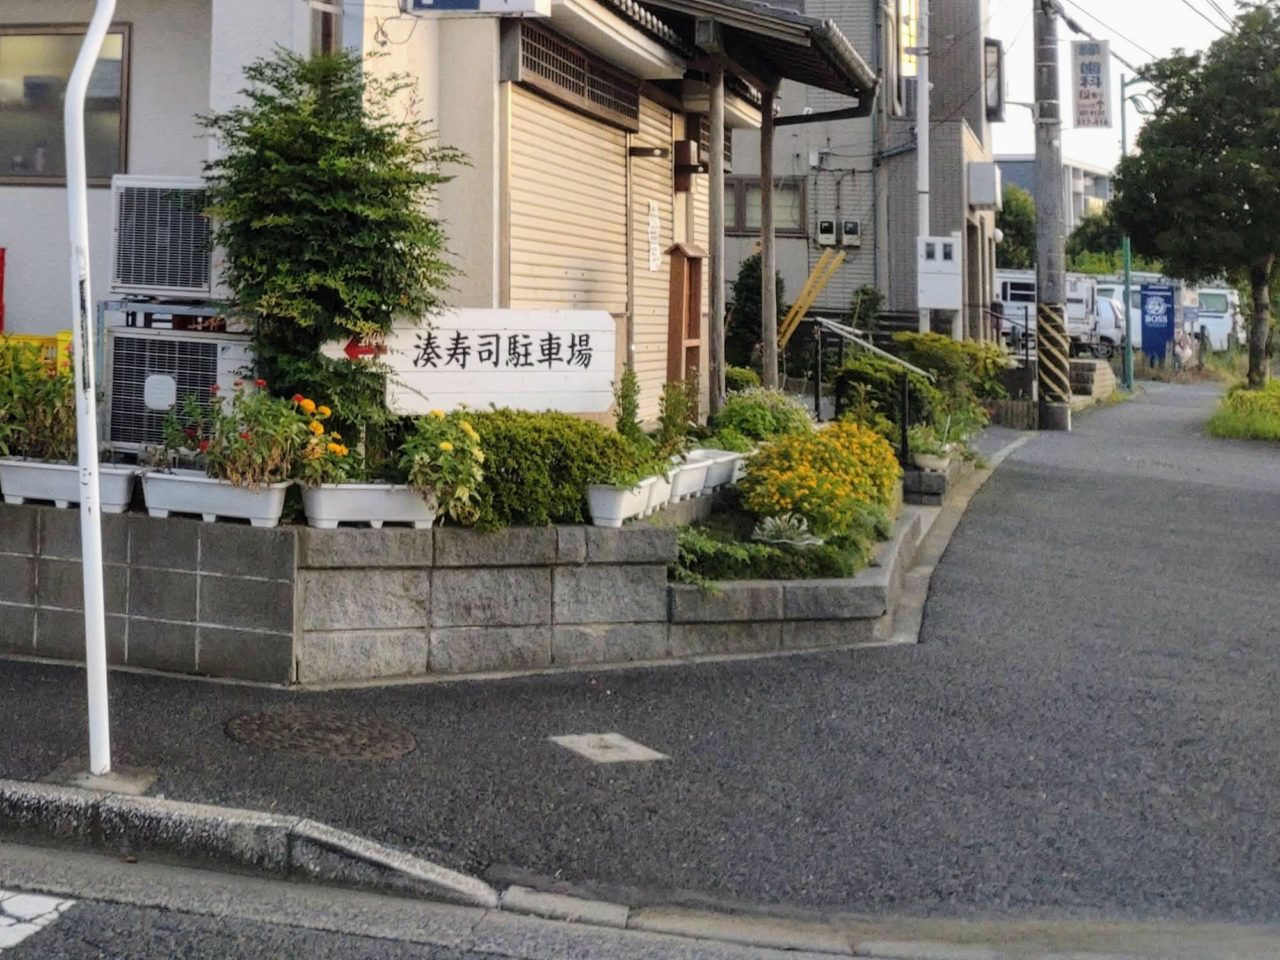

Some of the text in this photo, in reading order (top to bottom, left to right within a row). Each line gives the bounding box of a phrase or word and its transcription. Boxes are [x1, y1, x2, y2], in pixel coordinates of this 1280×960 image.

[1145, 315, 1168, 323] BOSS
[412, 329, 594, 370] 湊寿司駐車場
